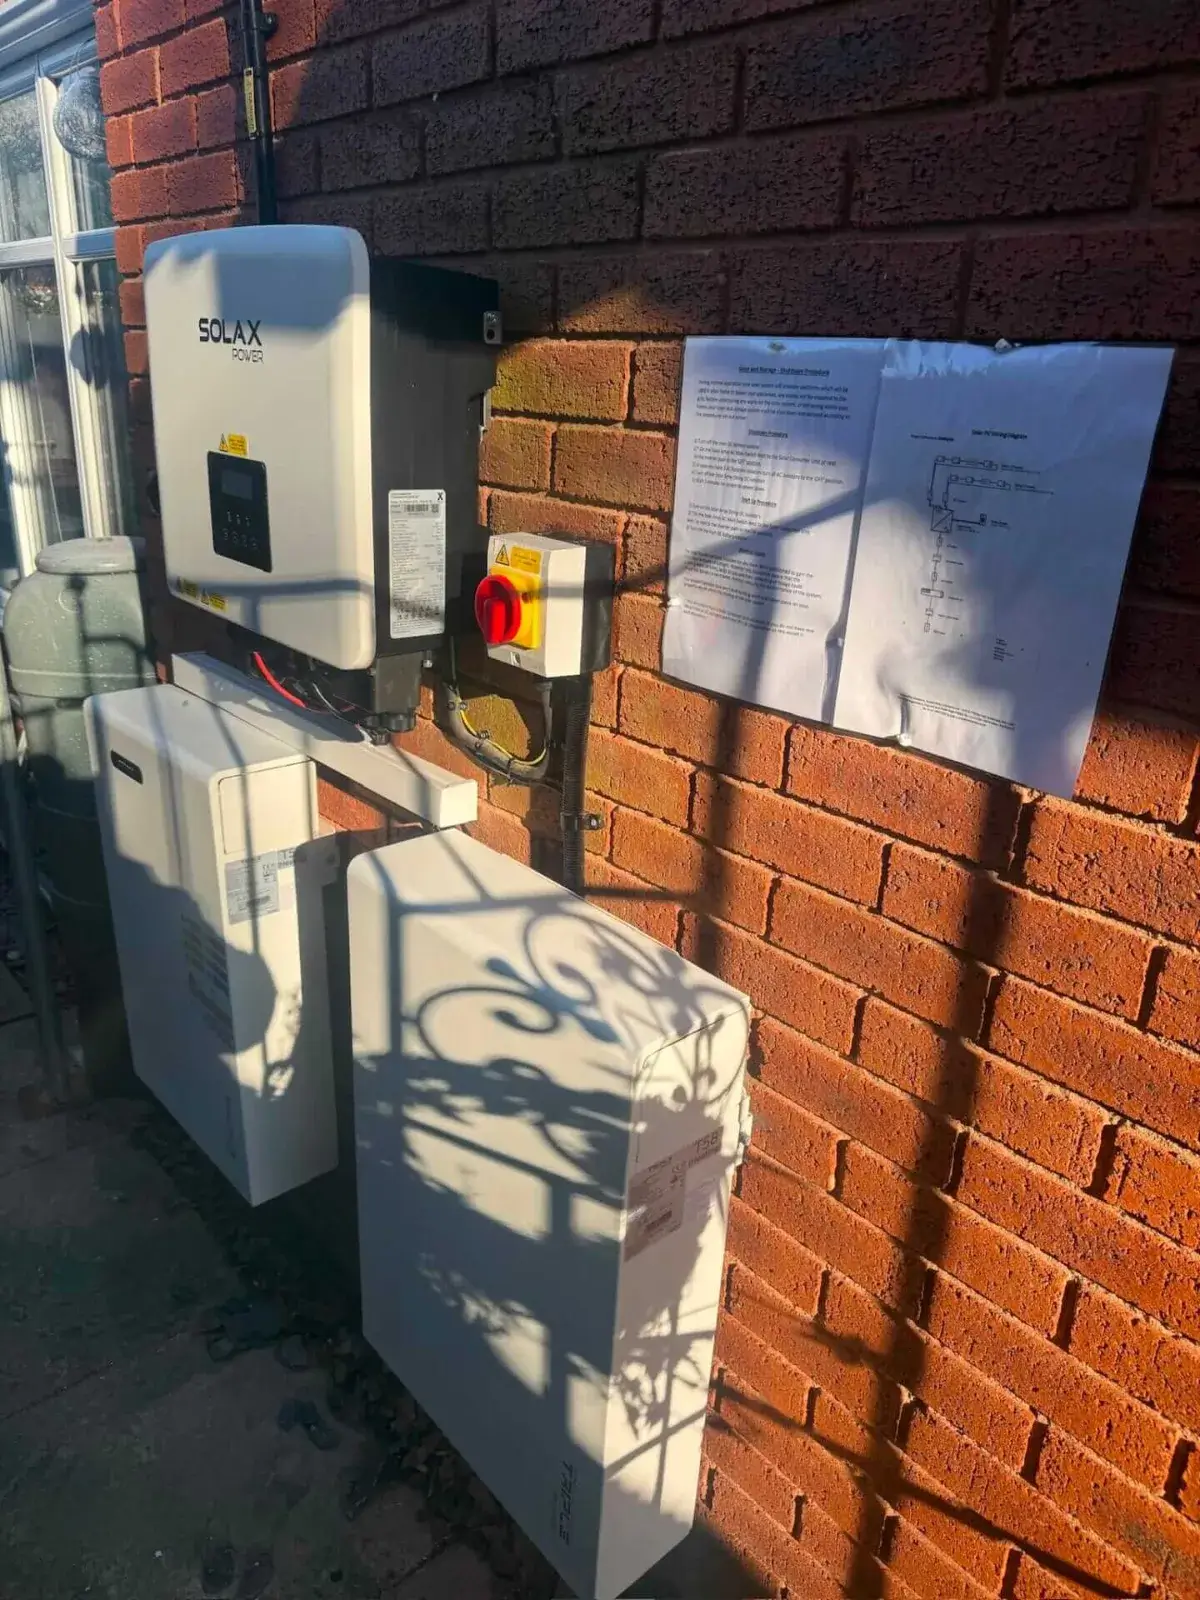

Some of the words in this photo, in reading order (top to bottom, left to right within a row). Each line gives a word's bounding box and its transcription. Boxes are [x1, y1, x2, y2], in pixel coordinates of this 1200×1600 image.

[199, 318, 262, 346] SOLAX
[232, 348, 264, 364] POWER
[437, 491, 444, 501] X
